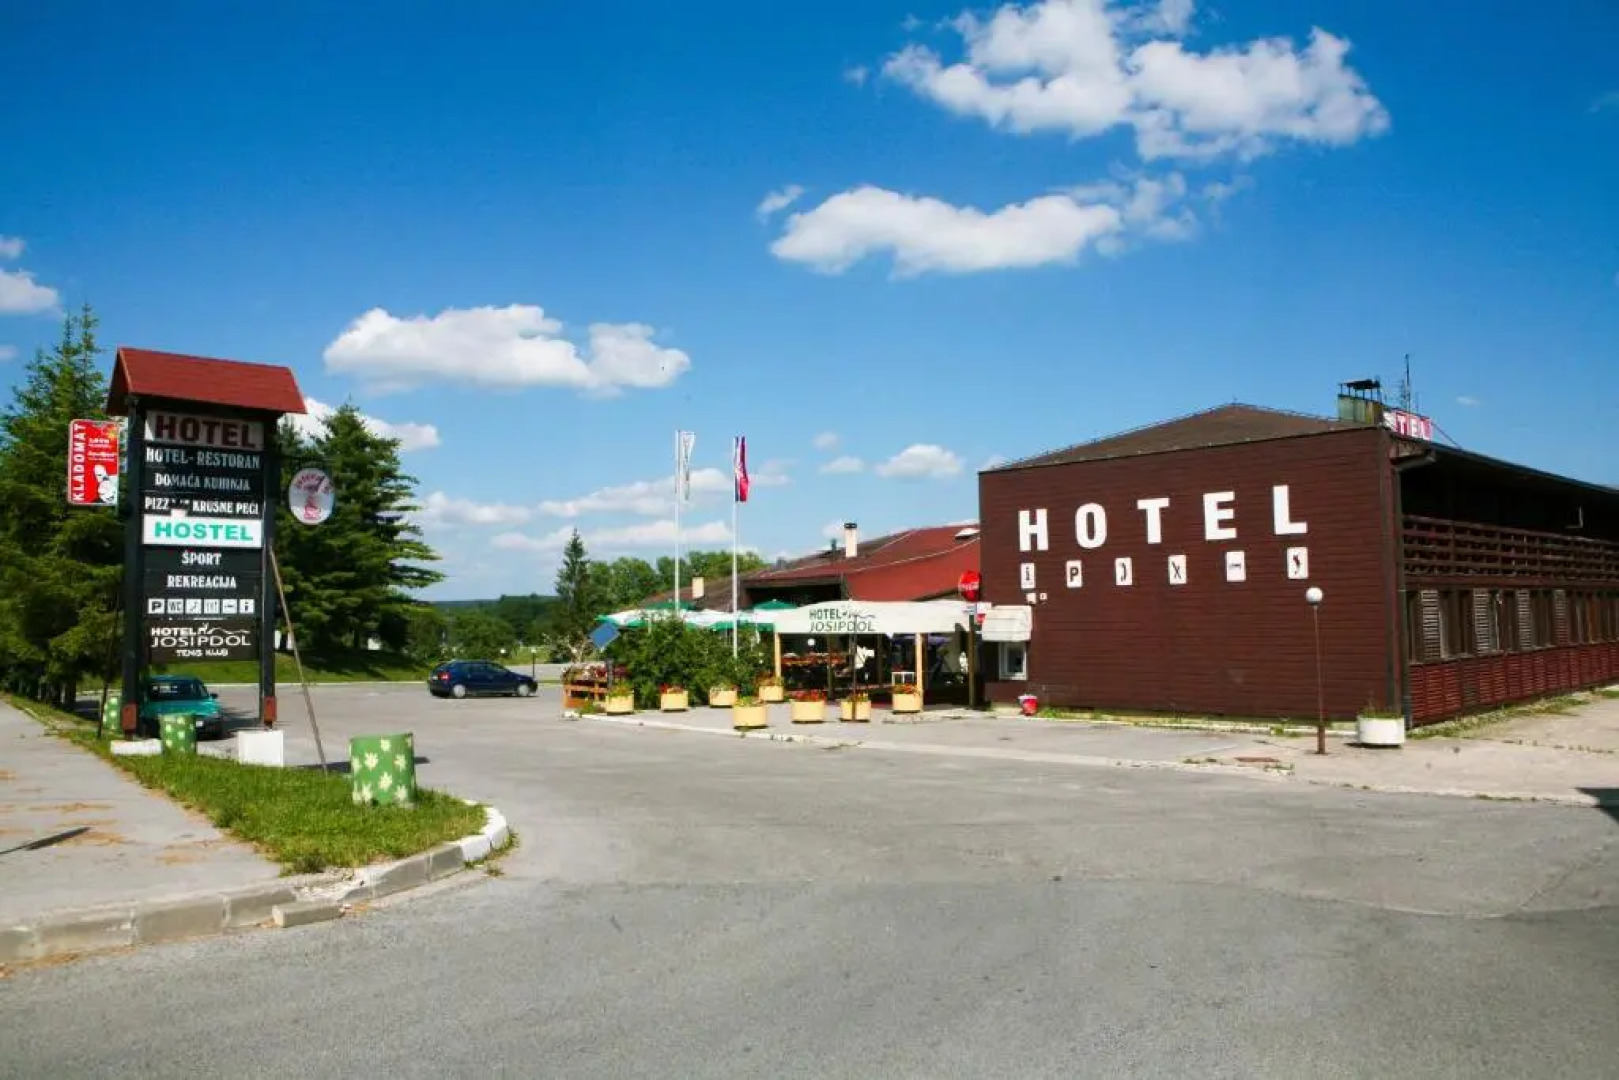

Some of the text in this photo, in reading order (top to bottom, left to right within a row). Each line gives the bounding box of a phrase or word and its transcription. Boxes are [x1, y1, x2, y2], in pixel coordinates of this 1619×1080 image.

[156, 415, 255, 448] HOTEL
[73, 423, 85, 501] KLADOMAT
[197, 451, 260, 469] RESTORAN
[1018, 484, 1308, 552] HOTEL
[154, 521, 254, 541] HOSTEL
[167, 574, 237, 589] REKREACIJA
[809, 608, 842, 620] HOTEL
[151, 627, 197, 637] HOTEL
[151, 635, 252, 648] JOSIPDOL
